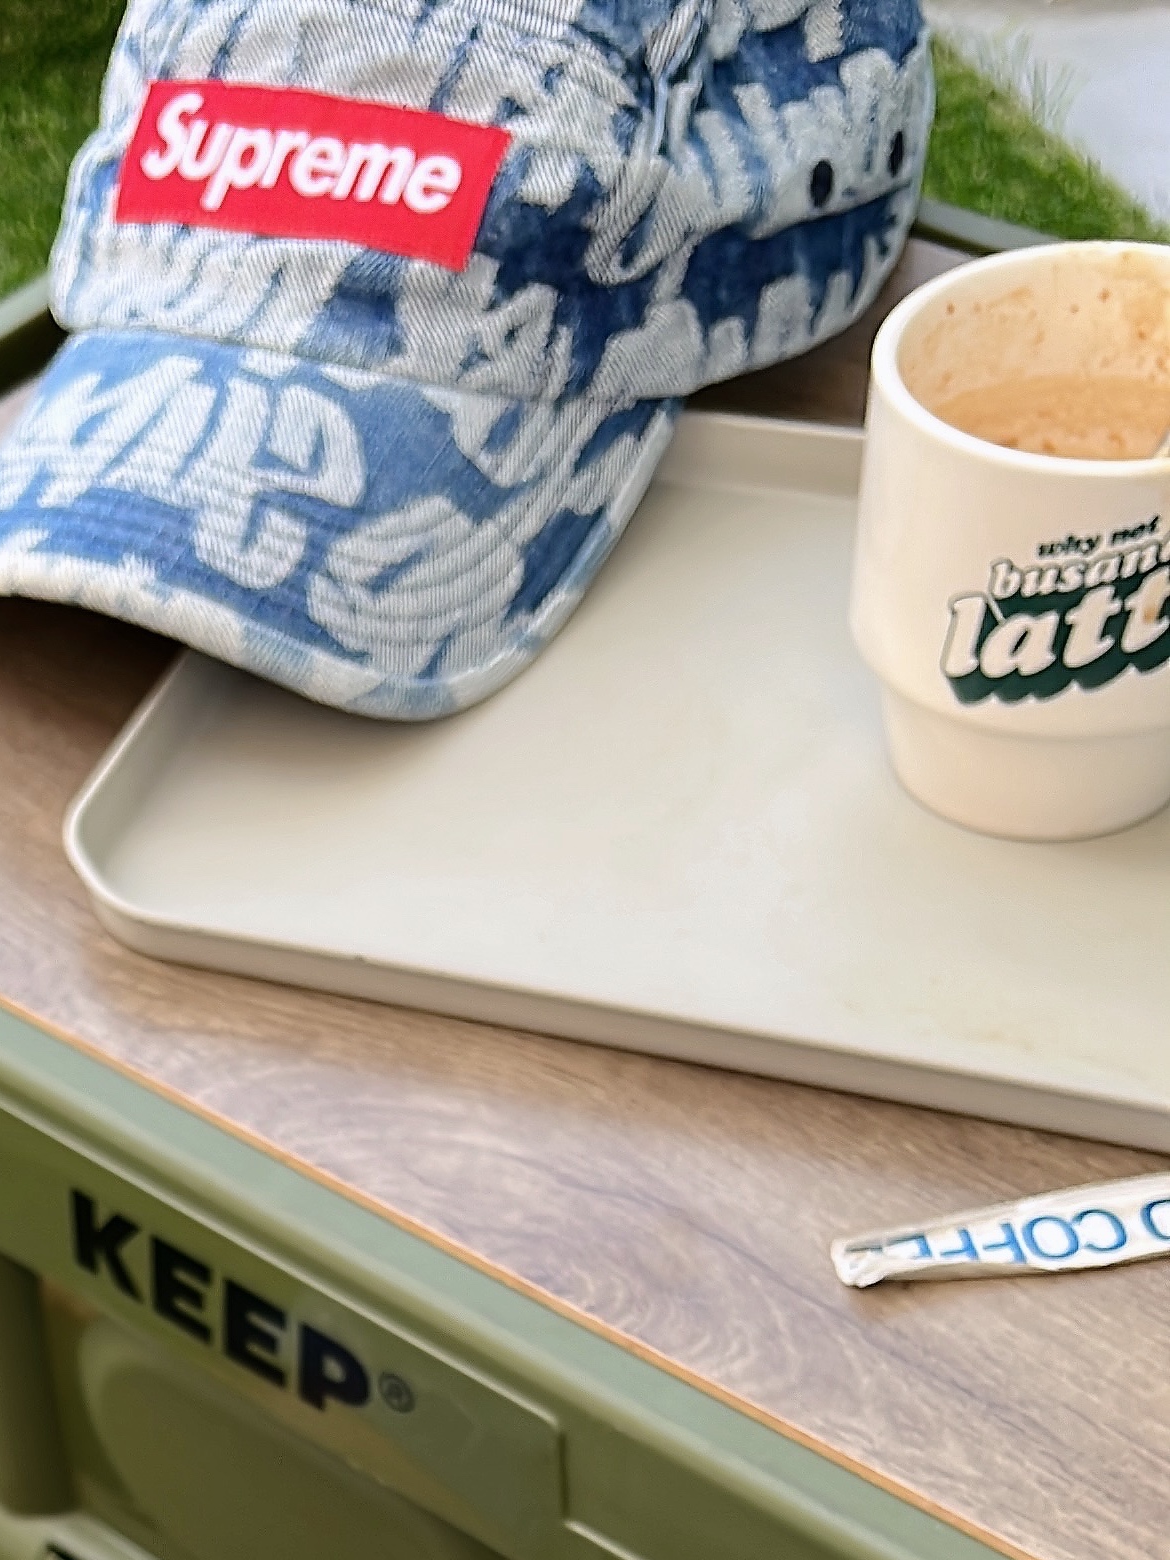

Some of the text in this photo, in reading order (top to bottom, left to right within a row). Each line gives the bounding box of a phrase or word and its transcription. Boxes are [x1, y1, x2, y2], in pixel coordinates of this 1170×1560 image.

[141, 91, 462, 213] Supreme
[1038, 514, 1160, 557] why not
[844, 1209, 1128, 1264] COFFE
